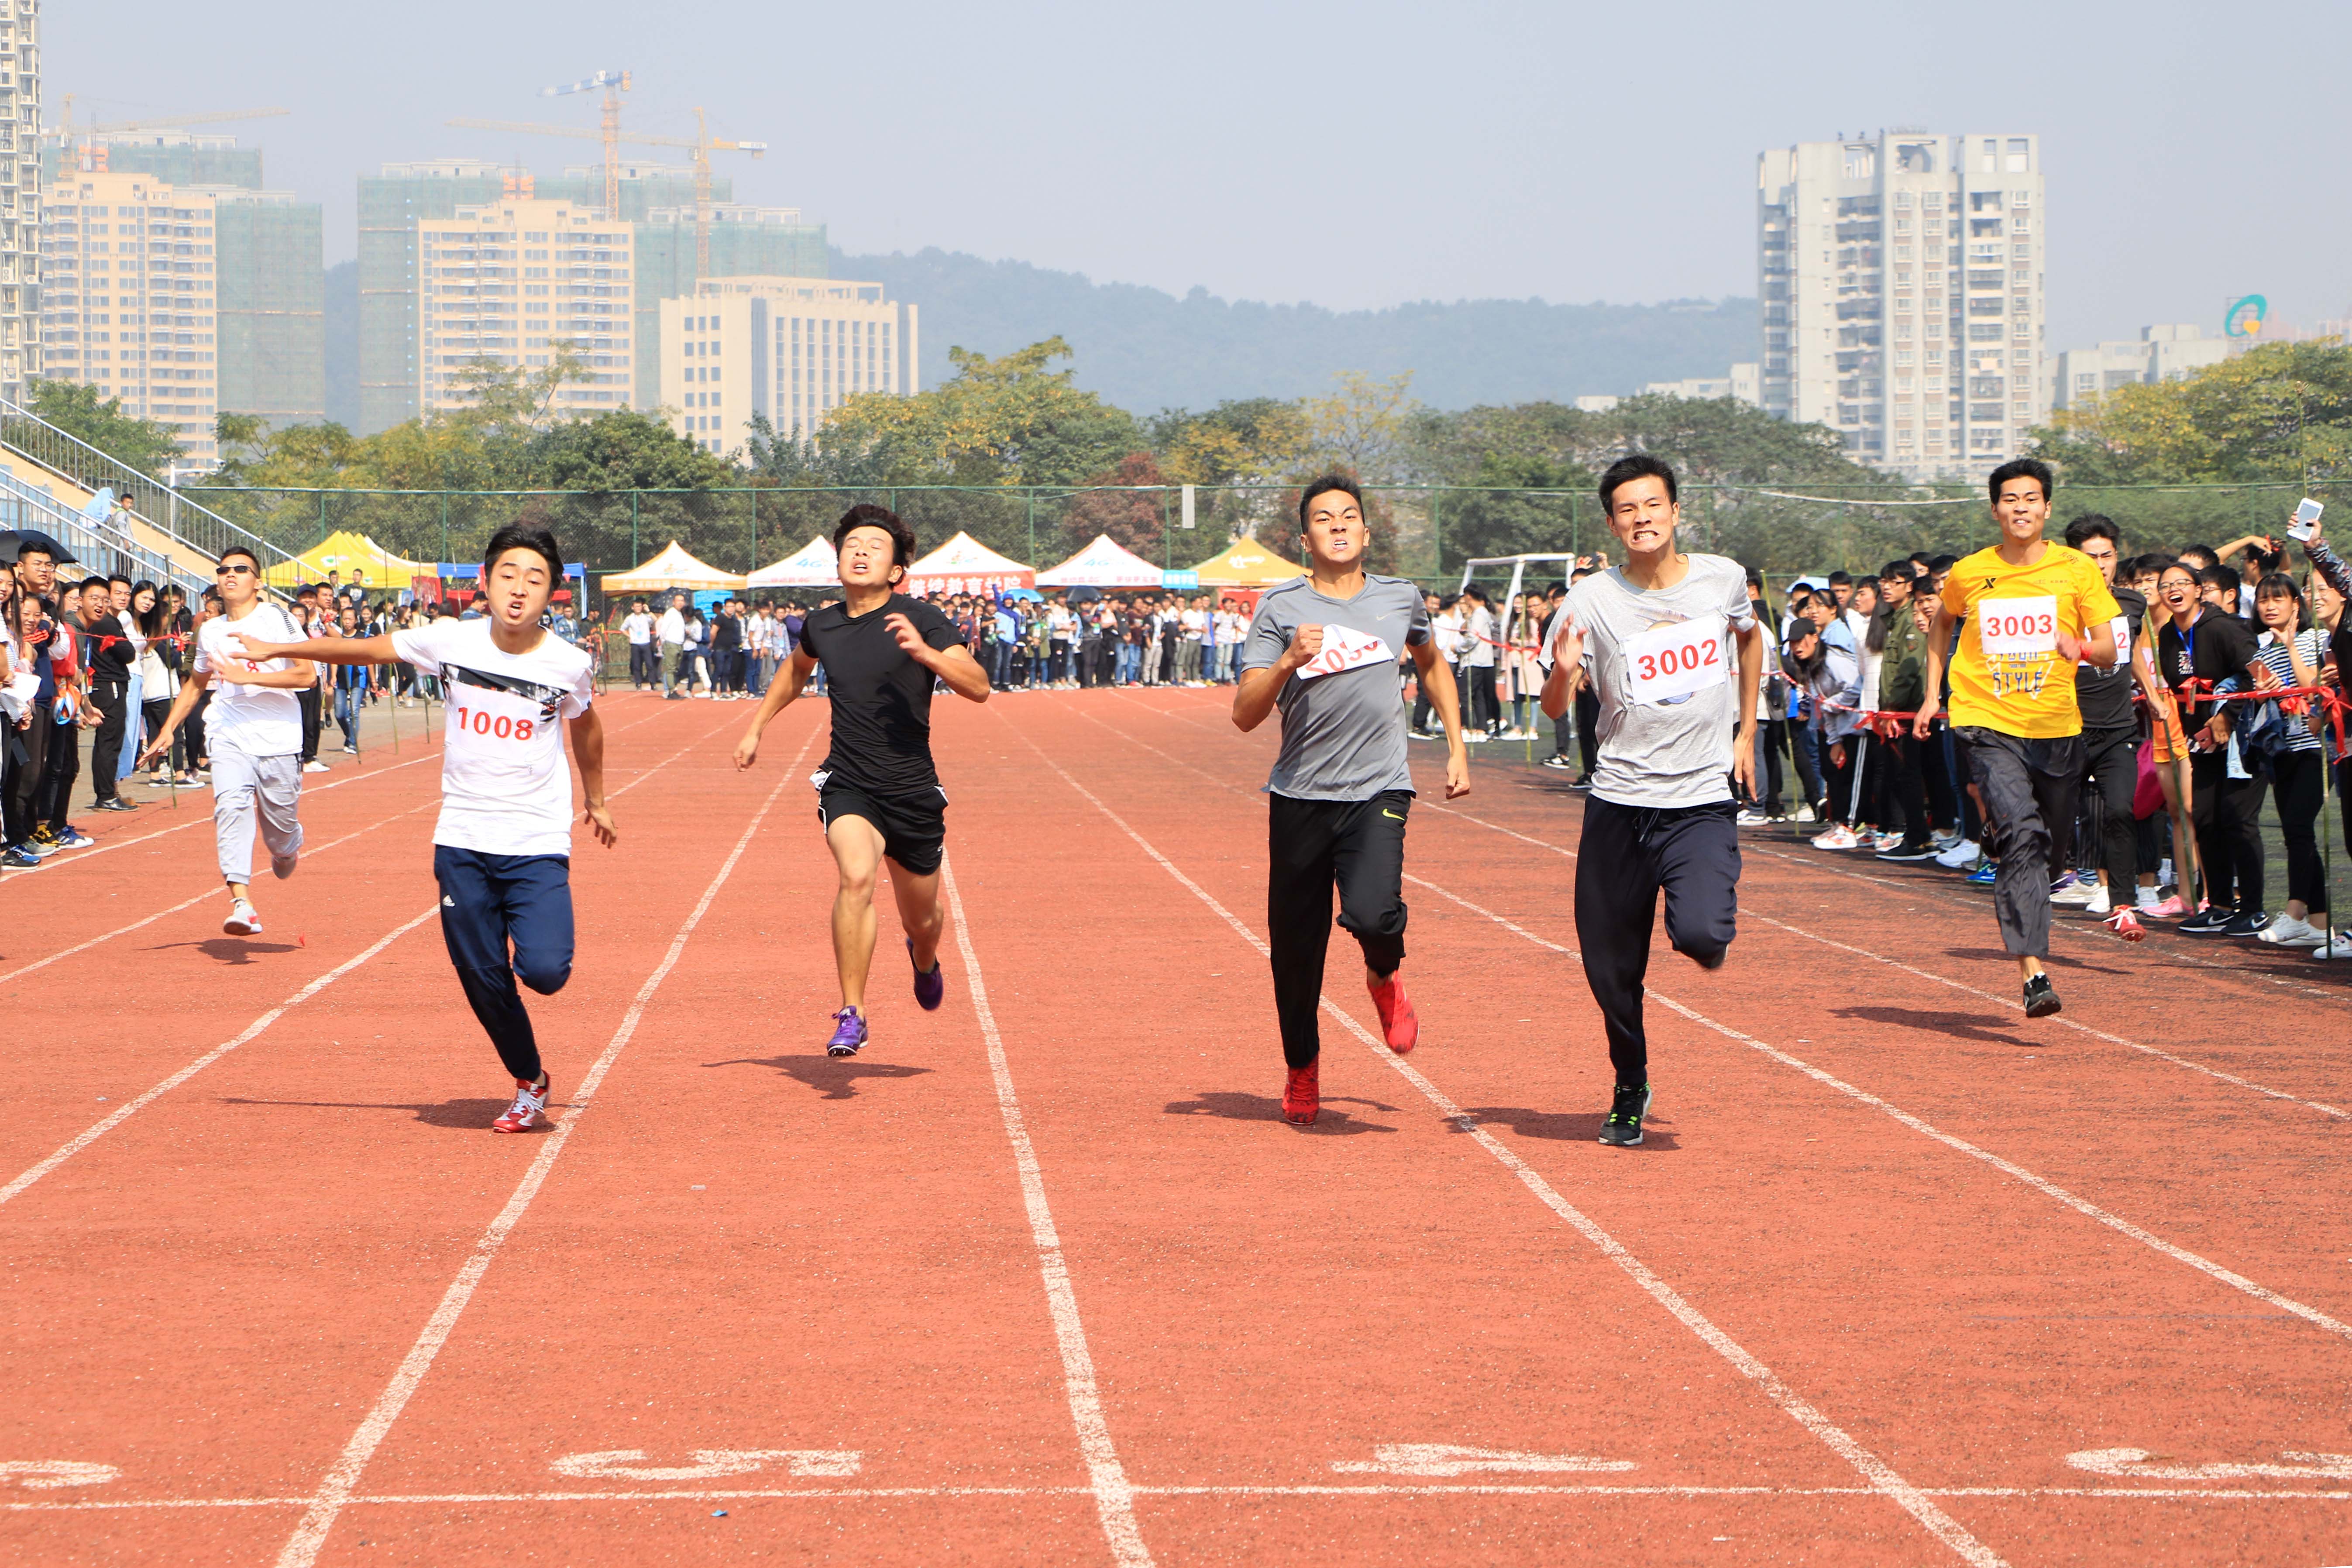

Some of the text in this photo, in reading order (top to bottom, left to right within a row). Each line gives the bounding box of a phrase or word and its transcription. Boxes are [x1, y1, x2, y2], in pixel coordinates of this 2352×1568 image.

[1987, 614, 2052, 637] 3003
[1638, 639, 1719, 681] 3002
[1993, 671, 2043, 693] STYLE
[458, 707, 533, 741] 1008
